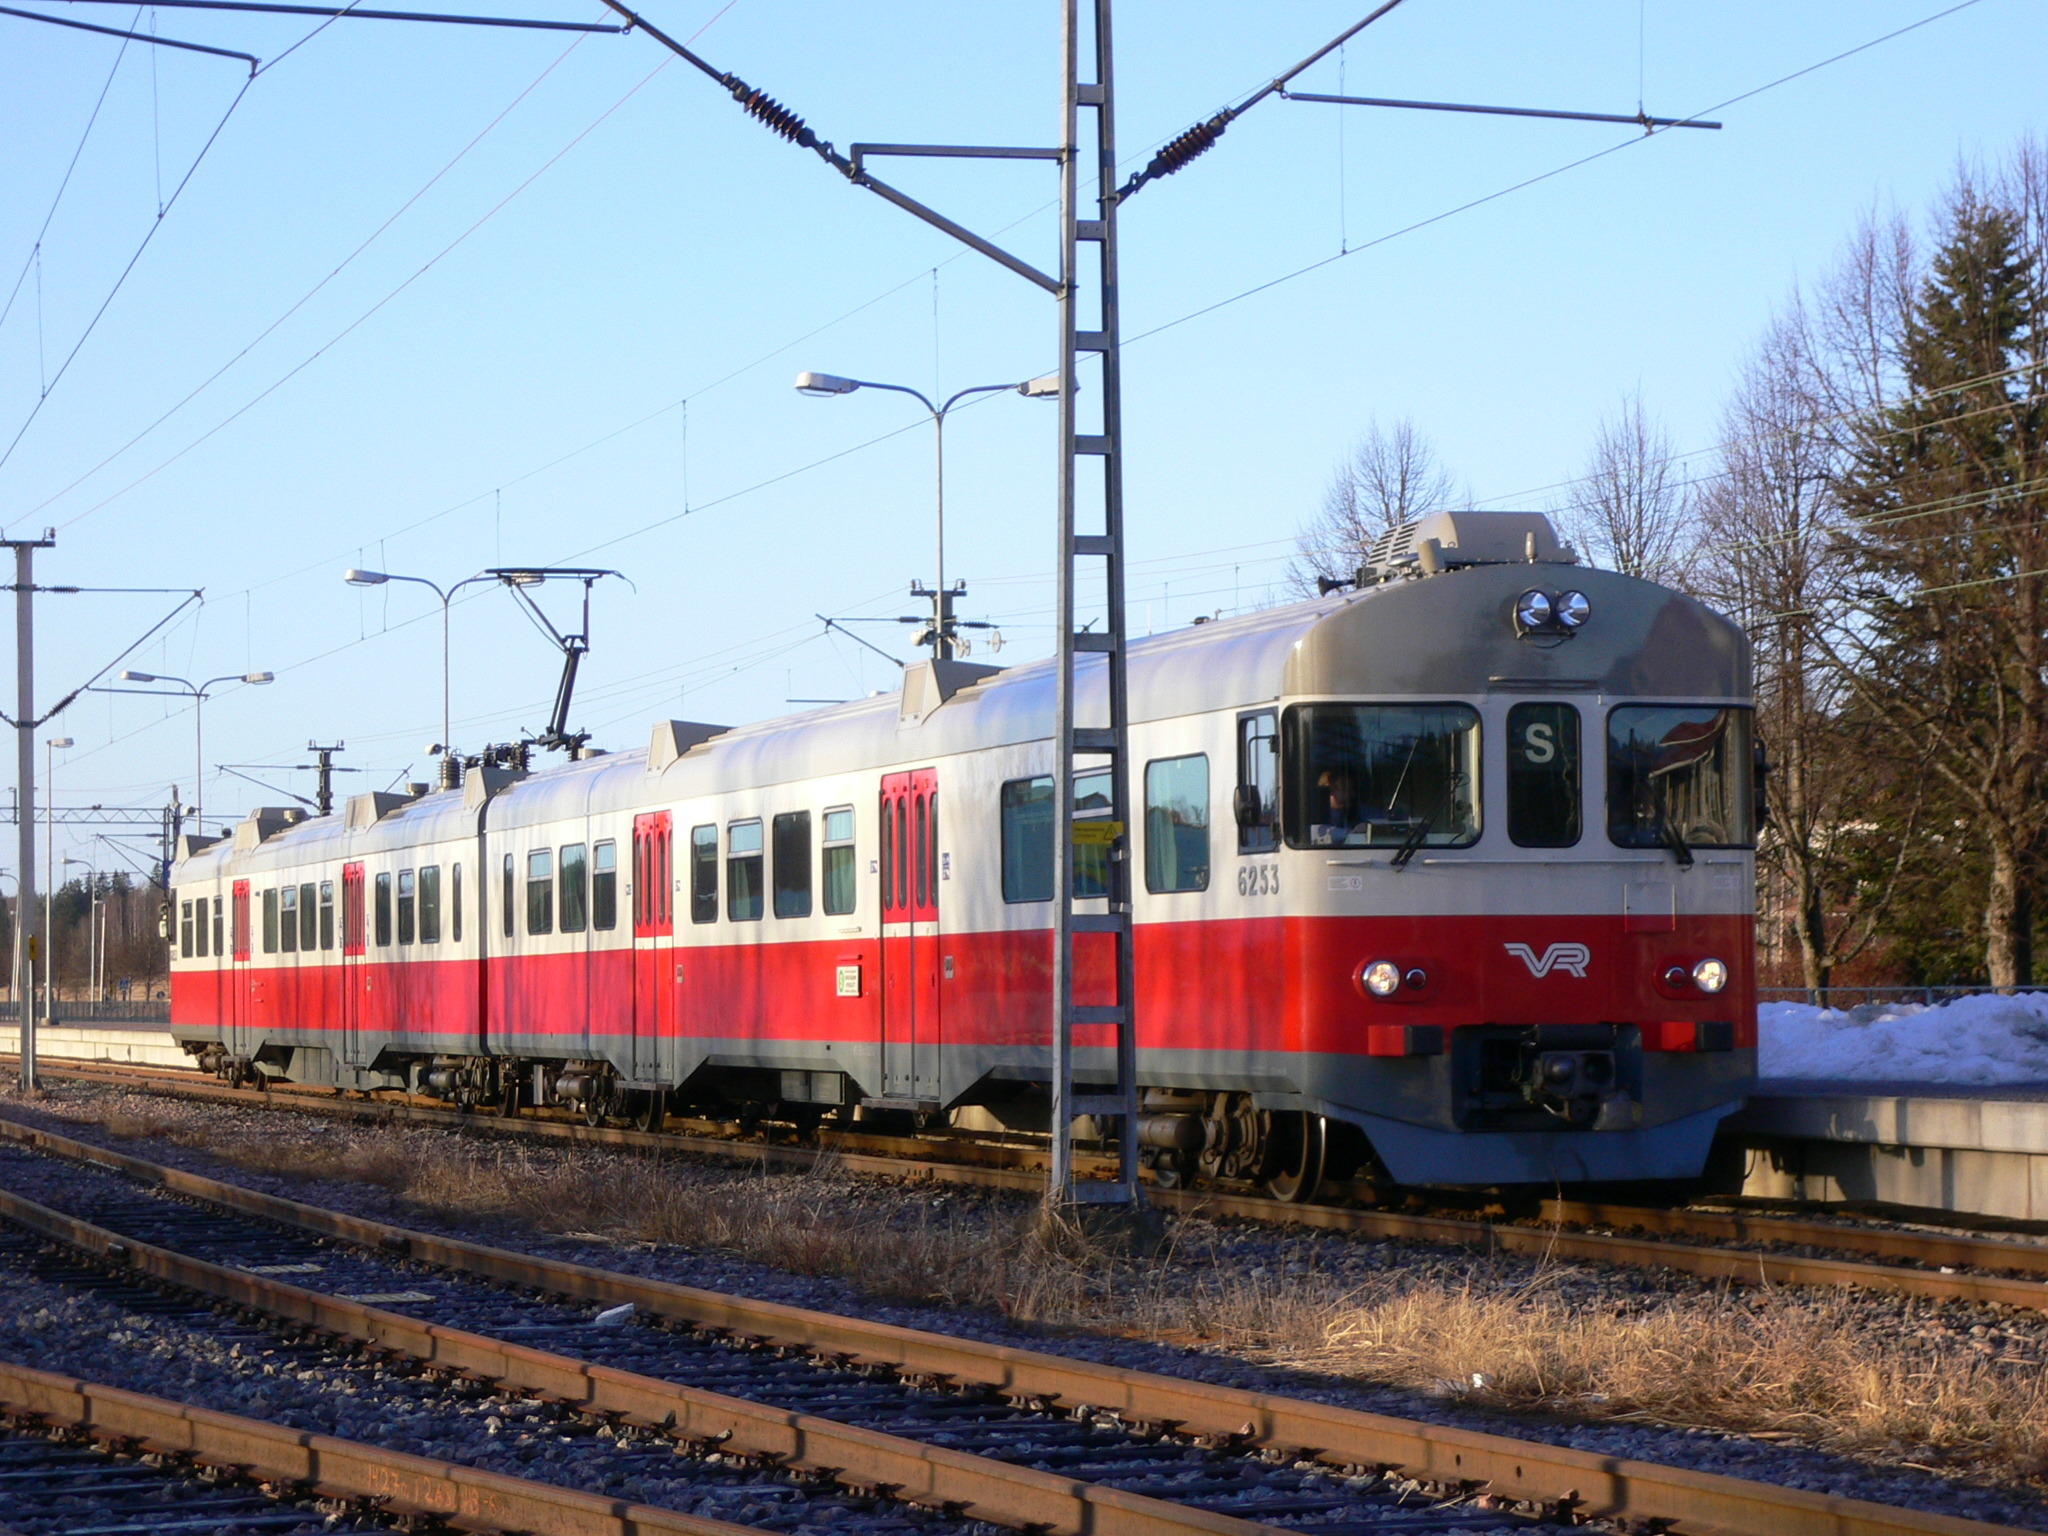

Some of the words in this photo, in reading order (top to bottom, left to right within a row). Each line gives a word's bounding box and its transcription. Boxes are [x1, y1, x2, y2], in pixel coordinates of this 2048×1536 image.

[1525, 722, 1554, 764] S
[1237, 864, 1280, 896] 6253
[1503, 942, 1590, 978] VR
